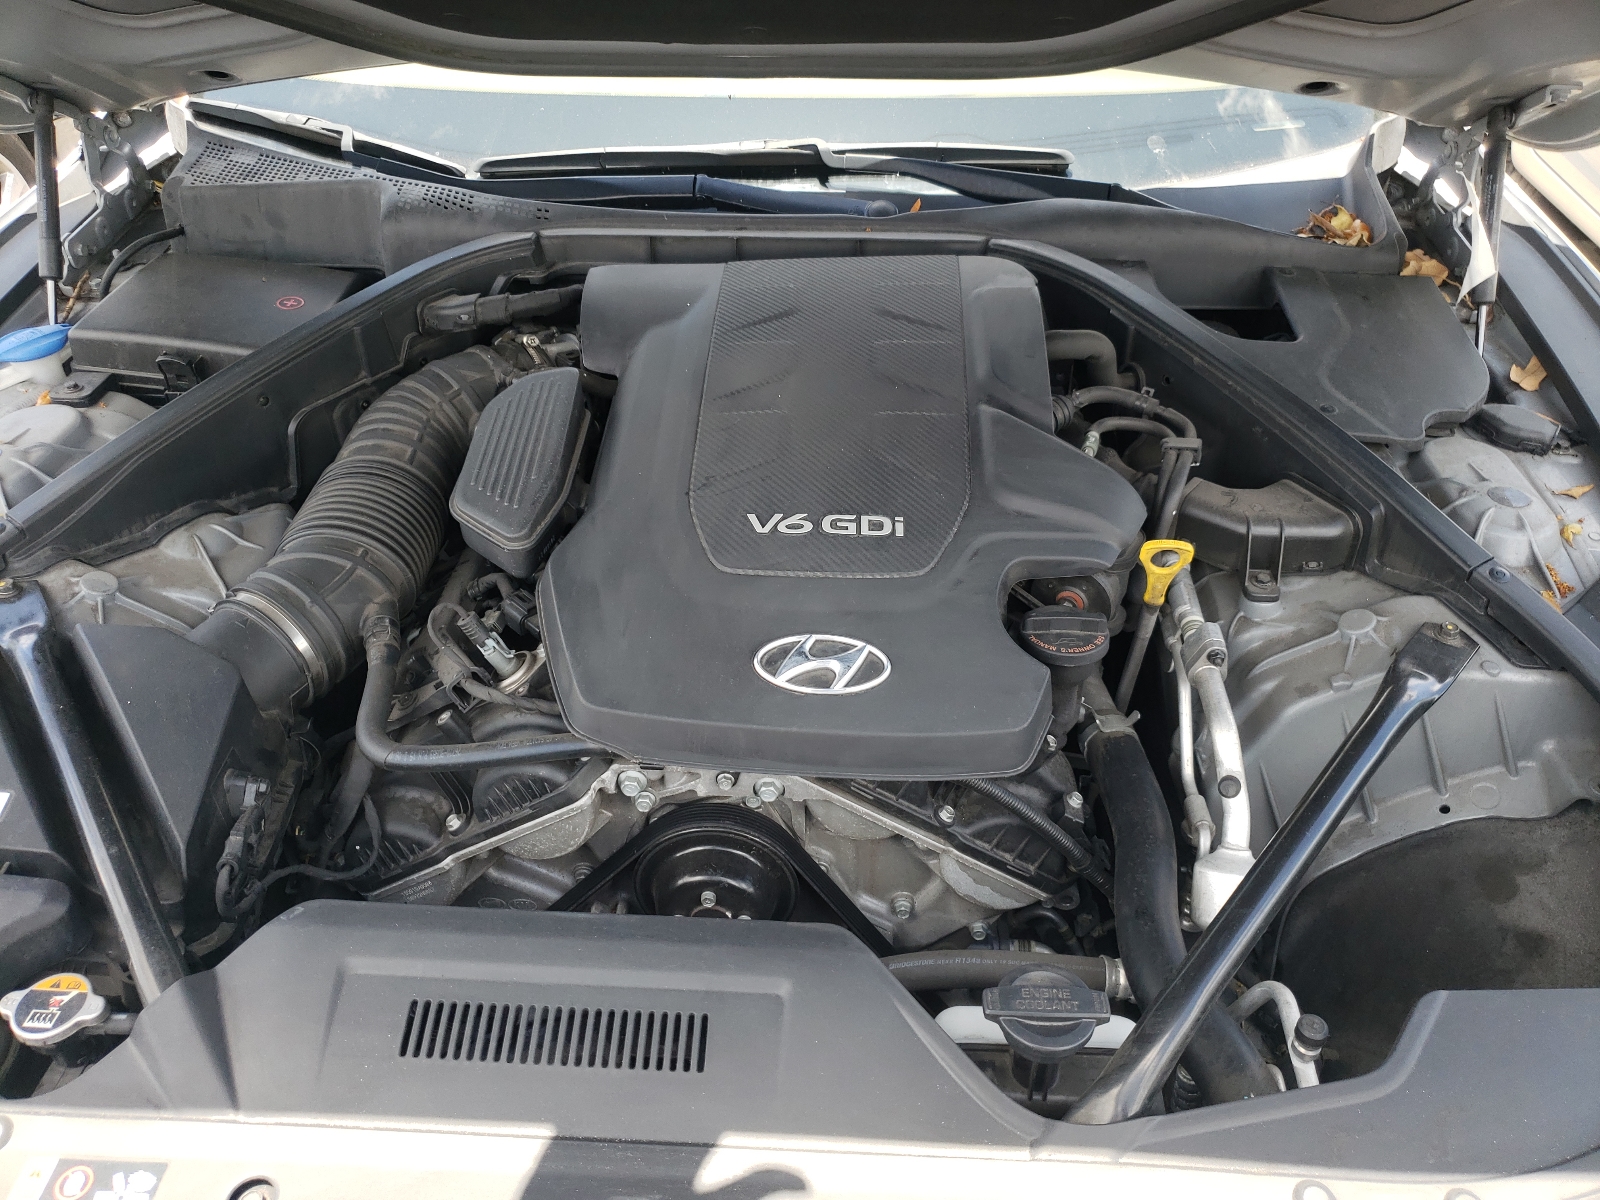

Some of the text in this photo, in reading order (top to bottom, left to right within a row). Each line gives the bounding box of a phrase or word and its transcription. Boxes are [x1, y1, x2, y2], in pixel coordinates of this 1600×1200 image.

[746, 513, 904, 537] V6 GDi
[1028, 634, 1058, 652] MANUAL
[1021, 988, 1072, 999] ENGINE
[1015, 1000, 1080, 1012] COOLANT
